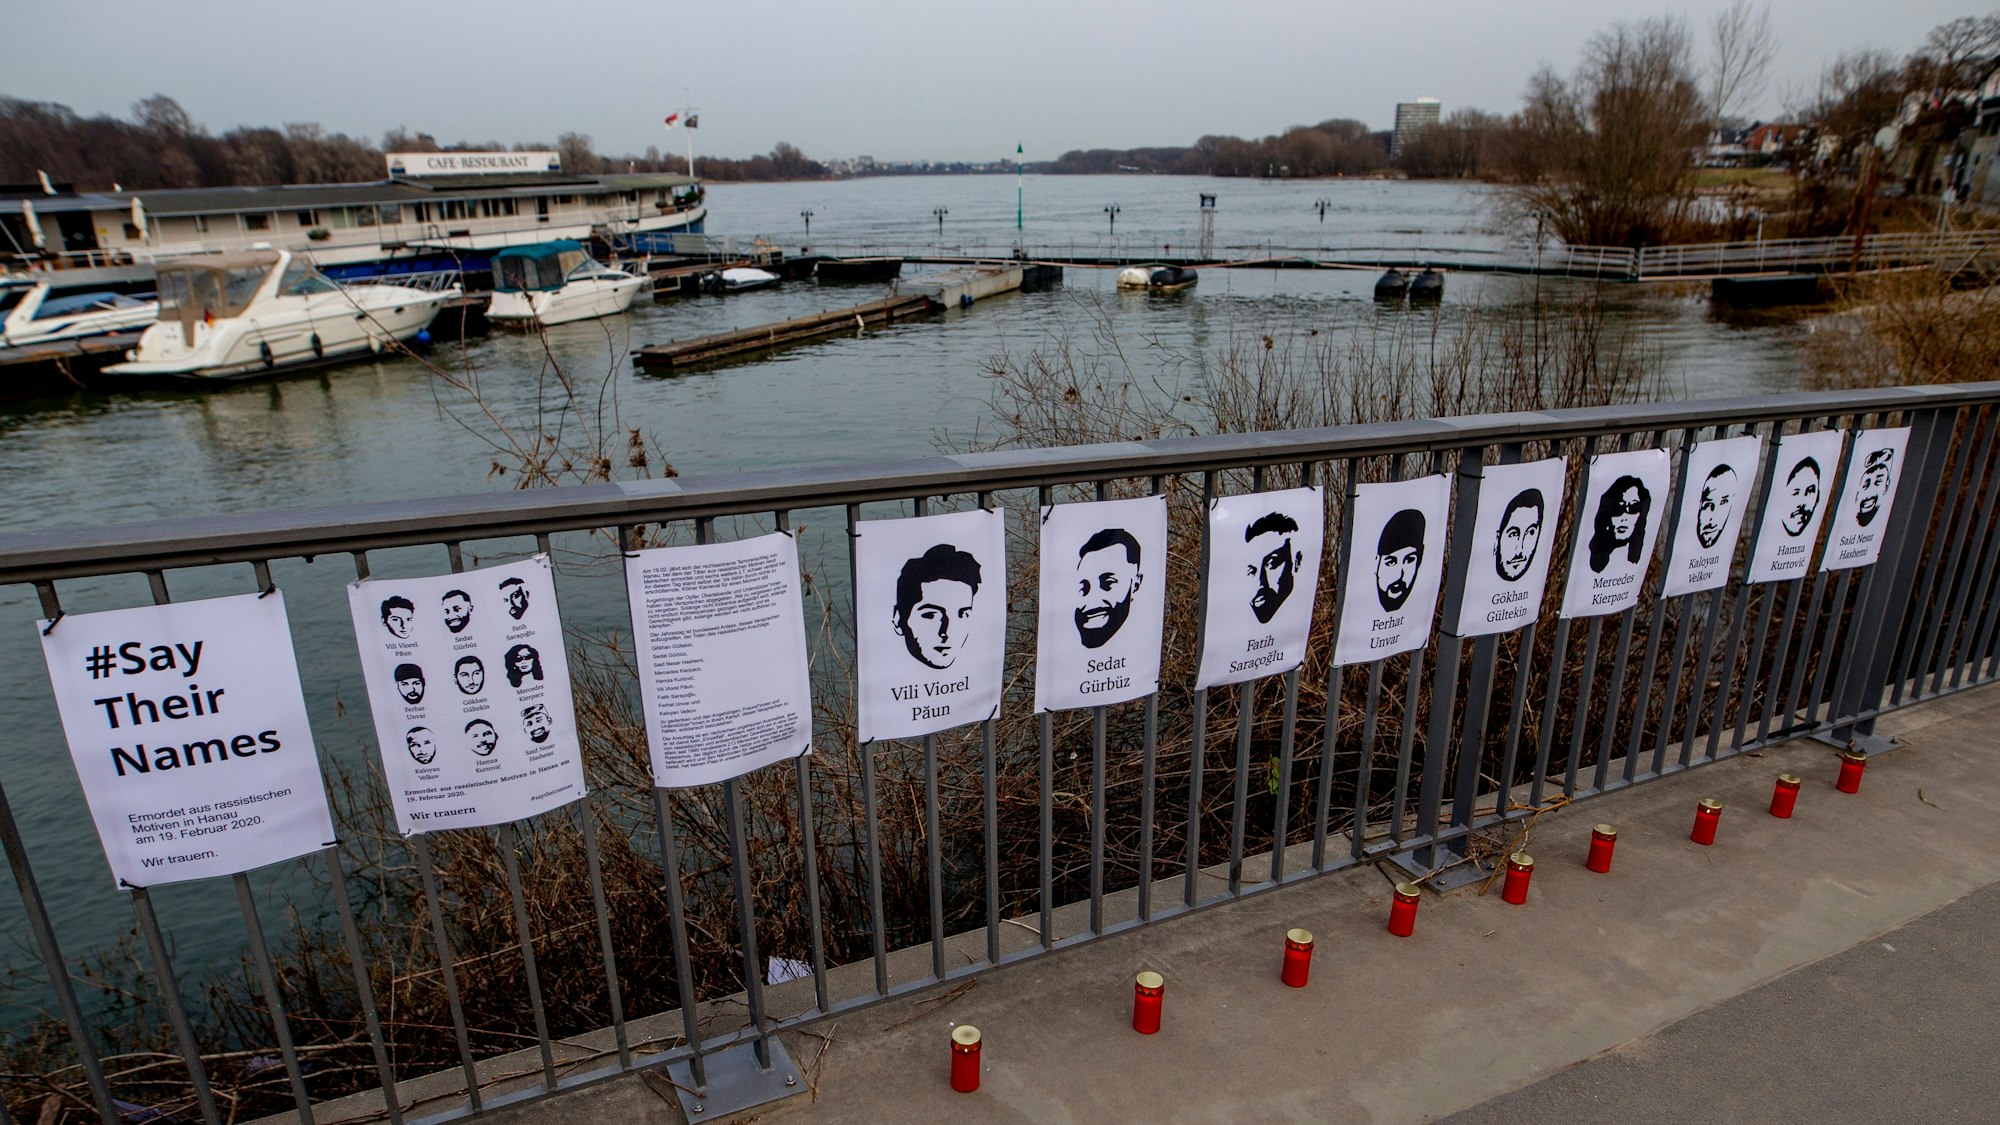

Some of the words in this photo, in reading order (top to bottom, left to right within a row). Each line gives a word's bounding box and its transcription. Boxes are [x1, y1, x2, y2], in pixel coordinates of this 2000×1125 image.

[1840, 536, 1856, 546] Said
[1858, 533, 1874, 543] Nesar
[1778, 545, 1805, 555] Hamza
[1839, 547, 1868, 560] Hashemi
[1688, 555, 1719, 569] Kaloyan
[1771, 557, 1805, 570] Kurtović
[1592, 574, 1634, 588] Mercedes
[1688, 571, 1713, 584] Velkov
[1492, 590, 1528, 605] Gökhan
[1592, 590, 1629, 605] Kierpacz
[1487, 606, 1527, 622] Gültekin
[1372, 615, 1405, 631] Ferhat
[1247, 635, 1274, 651] Fatih
[1370, 634, 1400, 649] Unvar
[85, 640, 203, 680] #Say
[1087, 656, 1126, 673] Sedat
[1230, 650, 1283, 673] Saraçoğlu
[517, 685, 544, 695] Mercedes
[891, 685, 918, 700] Vili
[924, 676, 969, 697] Viorel
[1080, 676, 1130, 694] Gürbüz
[519, 692, 544, 702] Kierpacz
[94, 683, 225, 728] Their
[463, 704, 490, 713] Gültekin
[912, 705, 950, 721] Păun
[110, 730, 281, 777] Names
[529, 750, 554, 762] Hashemi
[405, 788, 437, 796] Ermordet
[454, 779, 498, 790] rassistischen
[501, 773, 528, 782] Motiven
[538, 763, 558, 773] Hanau
[128, 807, 185, 823] Ermordet
[189, 803, 212, 814] aus
[215, 787, 292, 812] rassistischen
[410, 812, 430, 820] Wir
[434, 807, 476, 818] trauern
[132, 819, 180, 834] Motiven
[183, 817, 194, 828] in
[198, 810, 238, 825] Hanau
[136, 835, 155, 845] am
[158, 830, 176, 842] 19.
[181, 823, 228, 839] Februar
[231, 816, 265, 830] 2020.
[141, 856, 165, 868] Wir
[167, 850, 219, 864] trauern.
